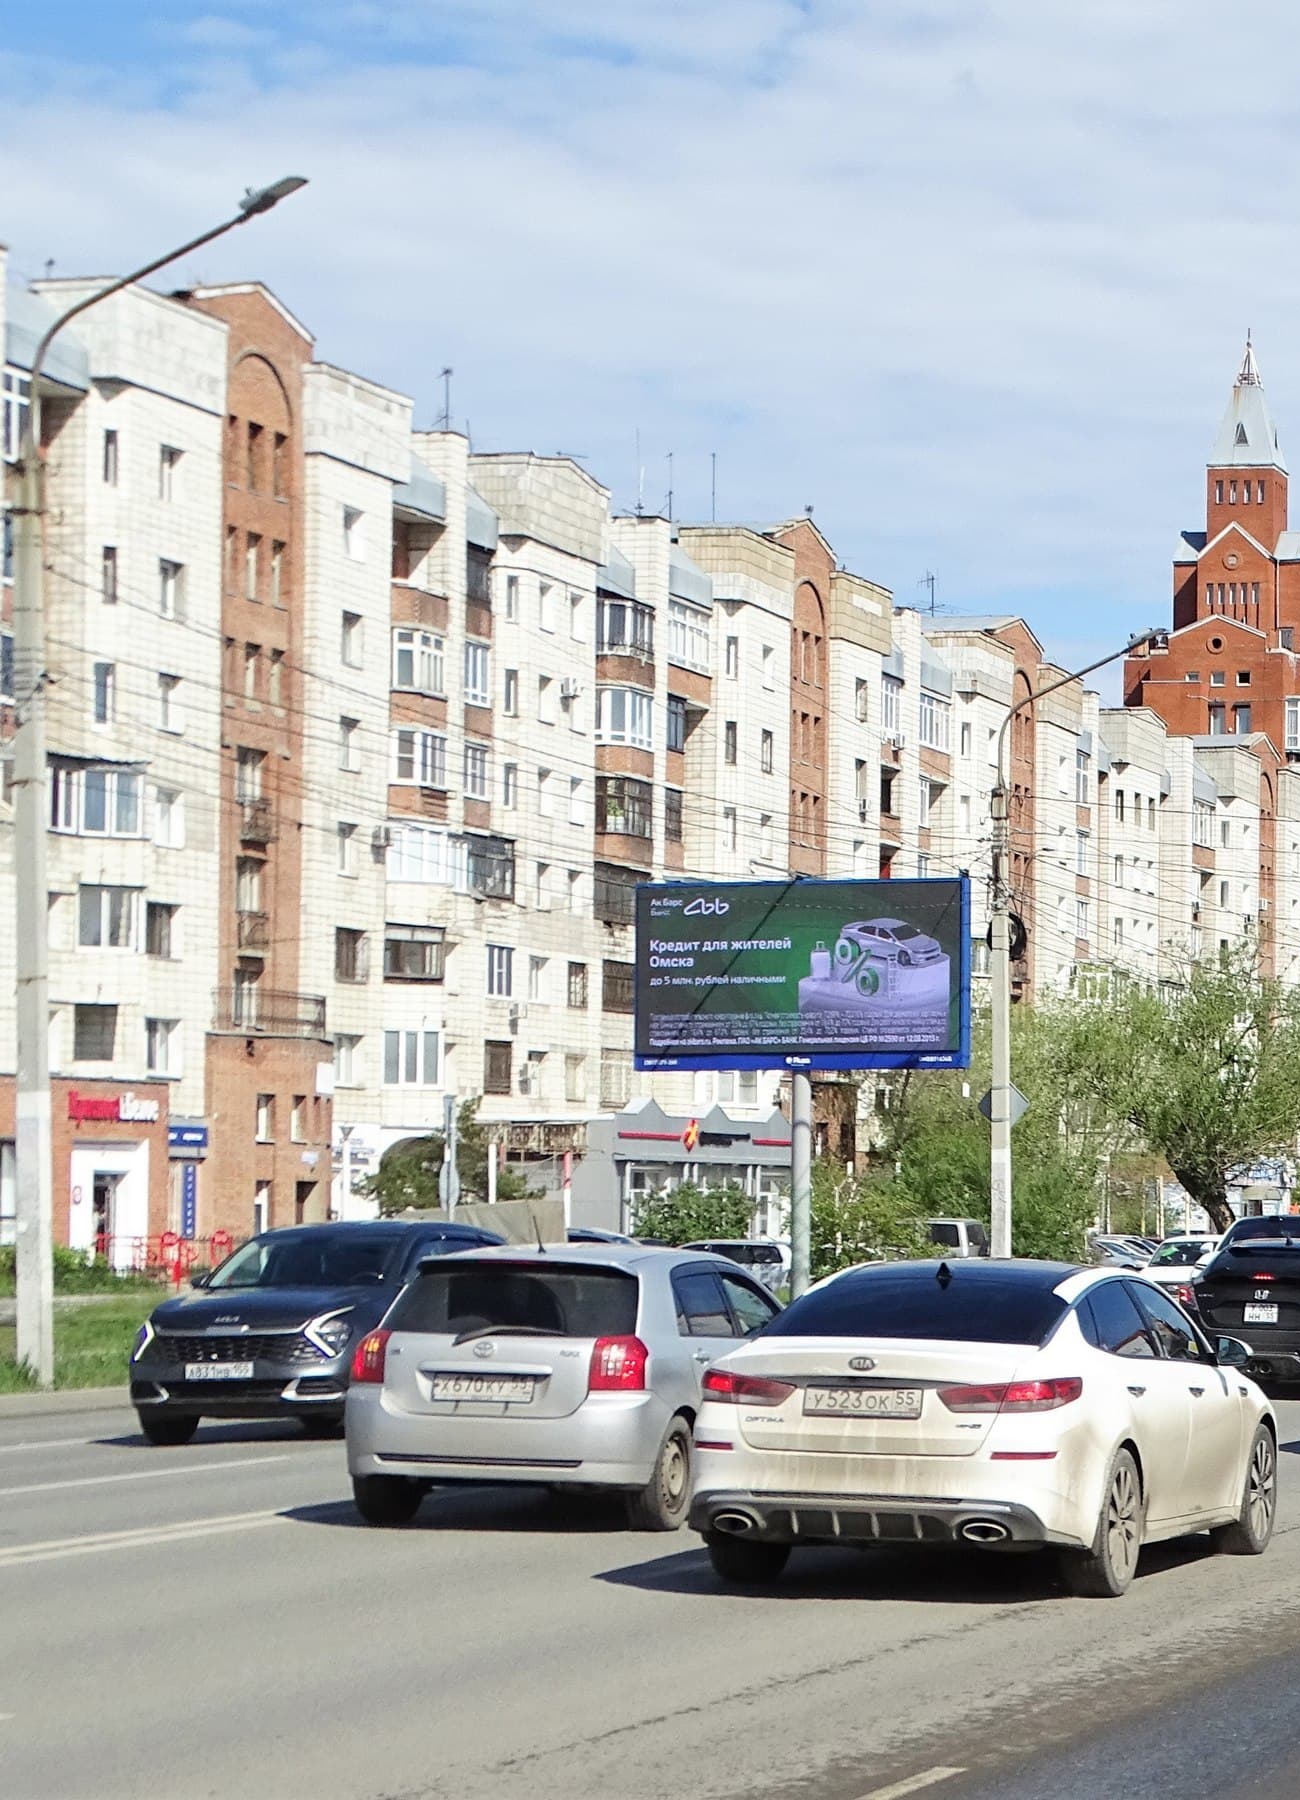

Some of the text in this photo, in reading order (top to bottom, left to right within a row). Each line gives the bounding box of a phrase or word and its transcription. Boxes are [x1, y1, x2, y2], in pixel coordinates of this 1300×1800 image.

[649, 937, 792, 953] Кредит для жителей
[649, 956, 694, 968] Омска
[649, 977, 662, 986] до
[664, 976, 670, 985] 5
[694, 974, 729, 986] рублей
[730, 975, 786, 984] наличными
[852, 1358, 873, 1369] KIA
[813, 1390, 915, 1410] У523ОК 55
